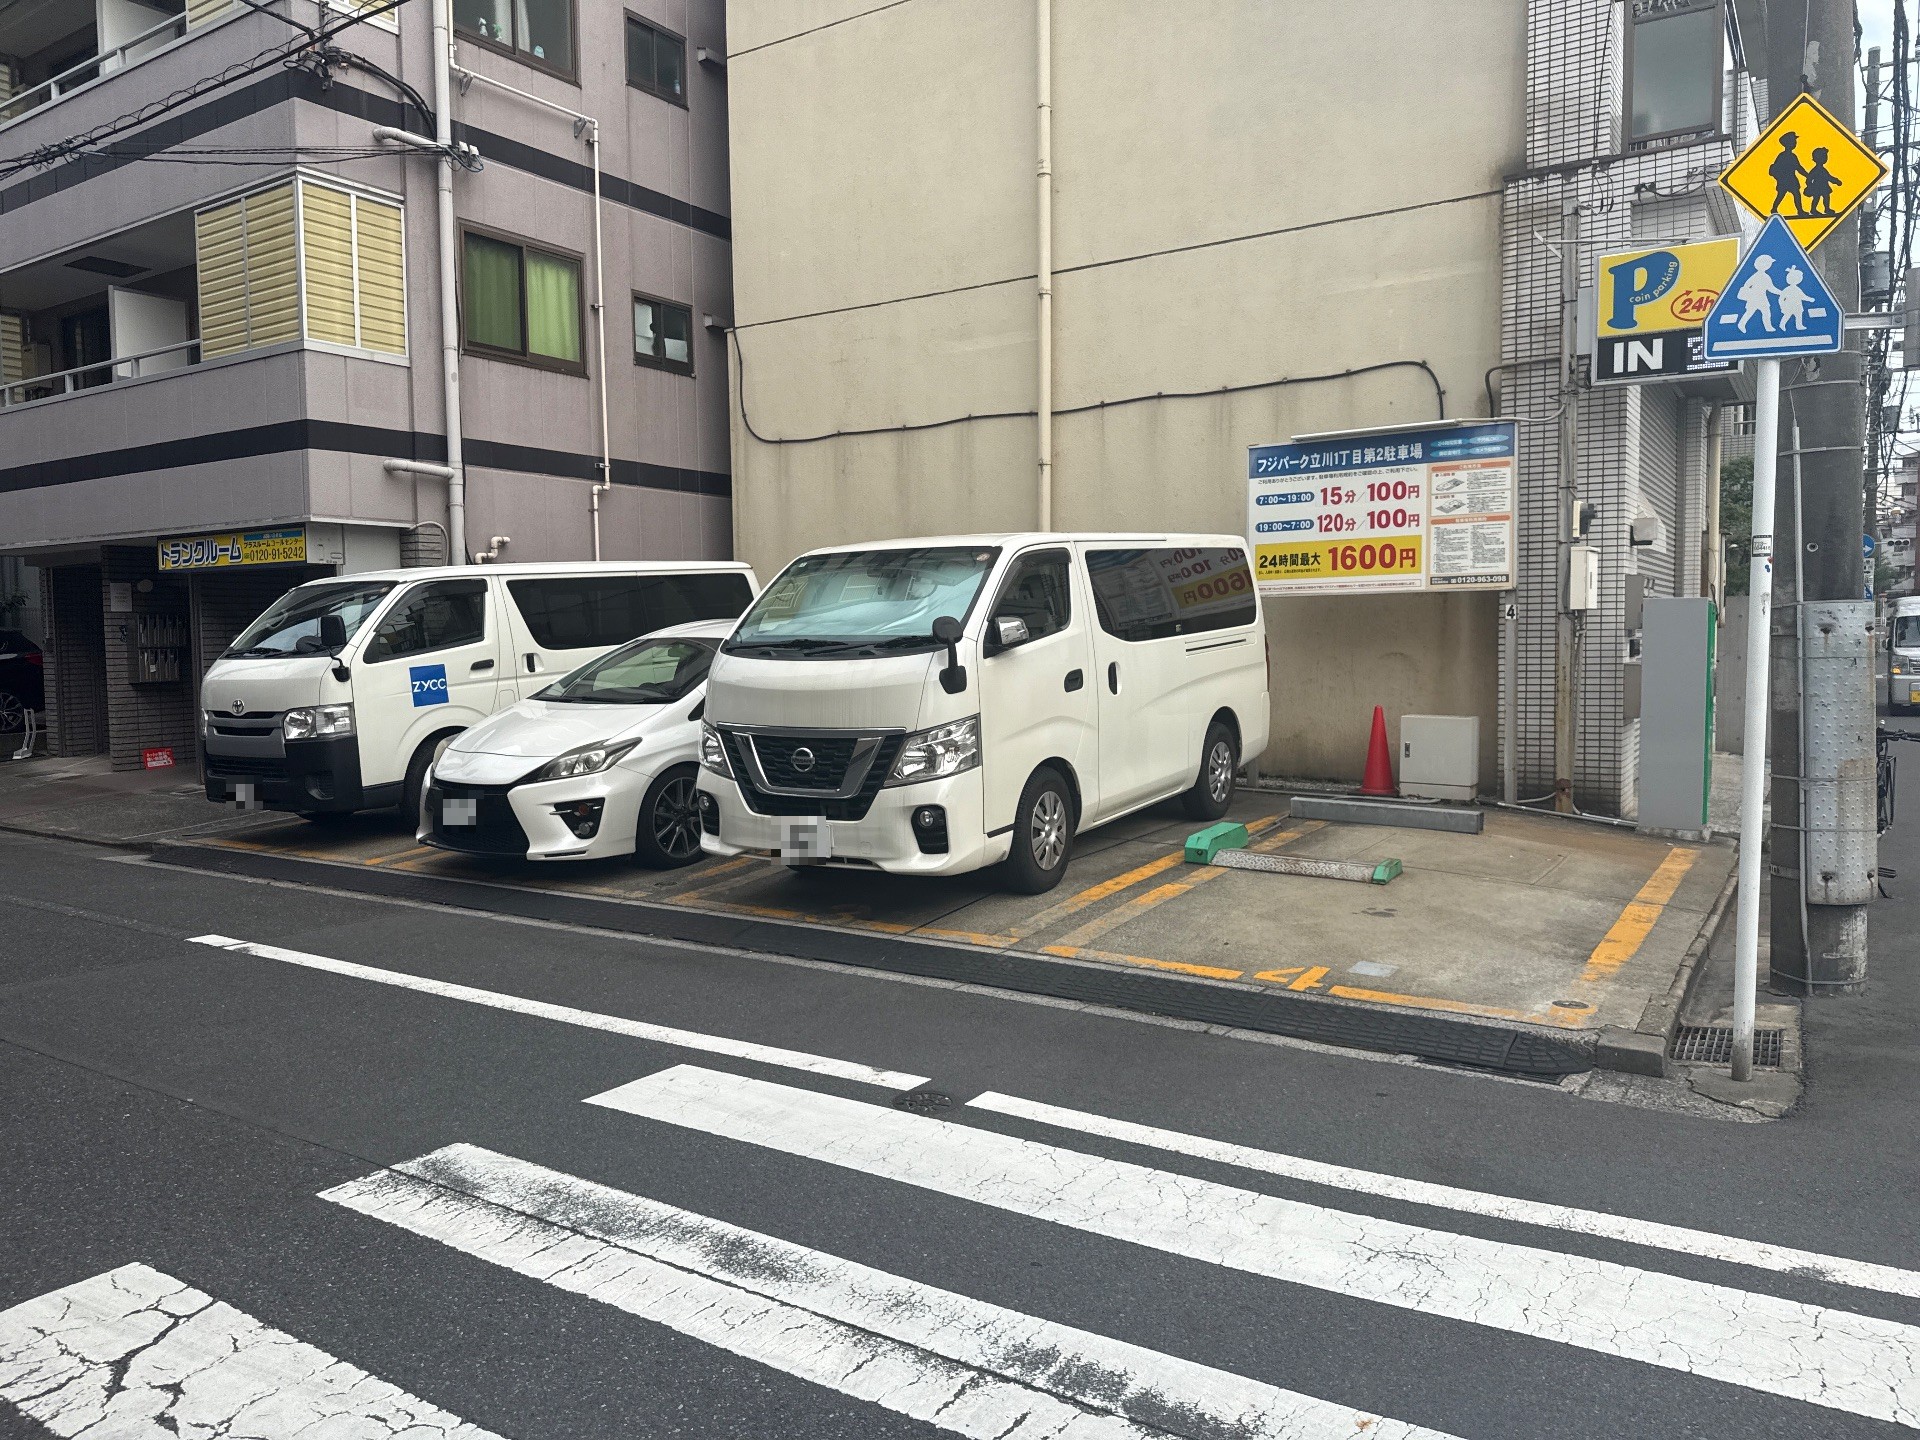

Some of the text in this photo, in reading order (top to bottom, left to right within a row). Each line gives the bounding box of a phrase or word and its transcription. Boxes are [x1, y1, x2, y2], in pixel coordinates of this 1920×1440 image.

[1607, 251, 1681, 330] P
[1629, 261, 1678, 303] coin parking
[1613, 338, 1664, 374] IN
[1257, 442, 1423, 473] フジパーク立川1丁目第2駐車場
[160, 536, 243, 568] トランクルーム
[1259, 551, 1321, 569] 24時間最大
[1328, 543, 1416, 571] 1600円
[1506, 604, 1516, 620] 4
[412, 678, 447, 693] ZYCC
